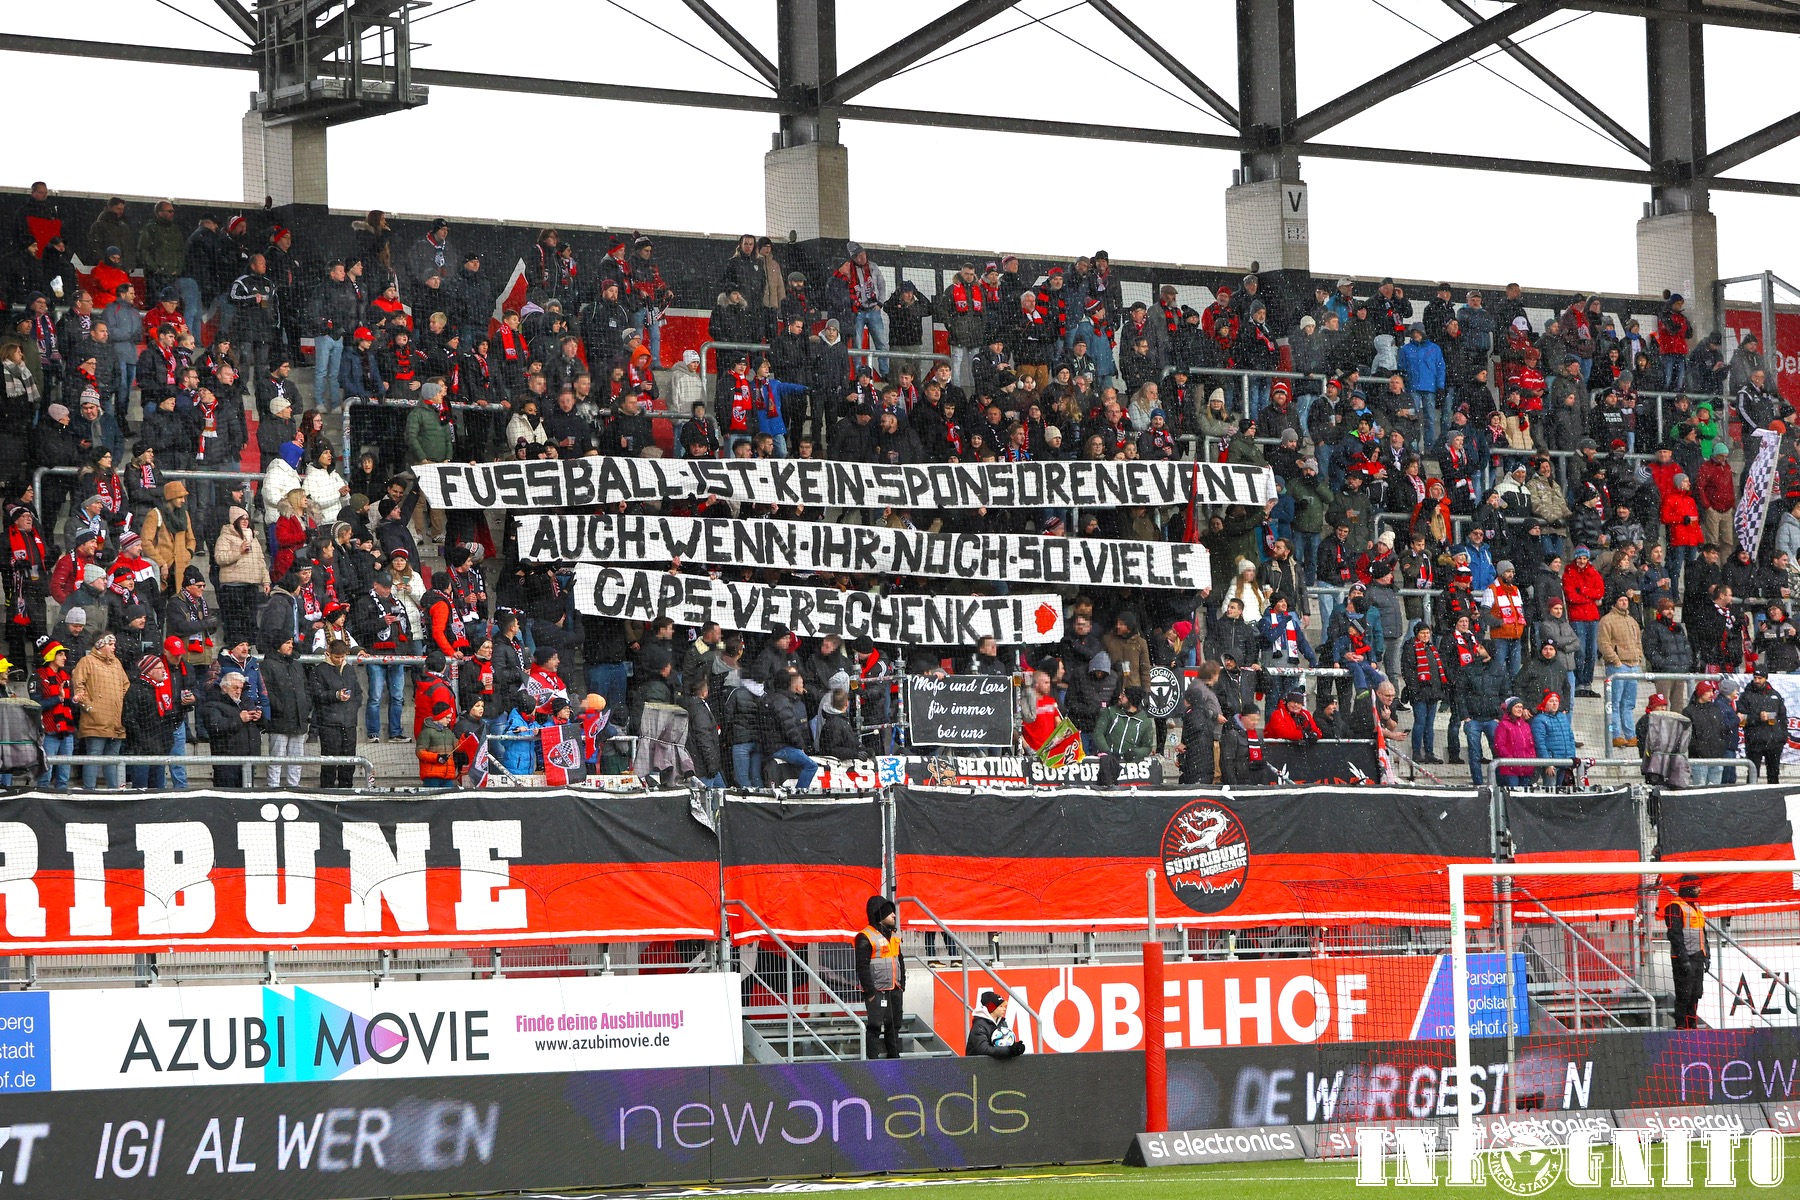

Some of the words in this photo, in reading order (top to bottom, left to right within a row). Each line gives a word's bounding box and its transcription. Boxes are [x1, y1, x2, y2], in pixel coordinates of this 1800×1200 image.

[1288, 191, 1302, 212] V
[949, 678, 977, 693] und
[979, 677, 1008, 695] Lars
[927, 699, 948, 720] für
[950, 702, 995, 716] immer
[937, 724, 958, 739] bei
[960, 728, 987, 739] uns
[516, 1015, 555, 1032] Finde
[557, 1013, 598, 1031] deine
[600, 1010, 684, 1030] Ausbildung!
[120, 1016, 285, 1074] AZUBI
[314, 1010, 489, 1067] MOVIE
[535, 1032, 670, 1051] www.azubimovie.de
[1148, 1133, 1171, 1158] si
[1173, 1126, 1296, 1155] electronics
